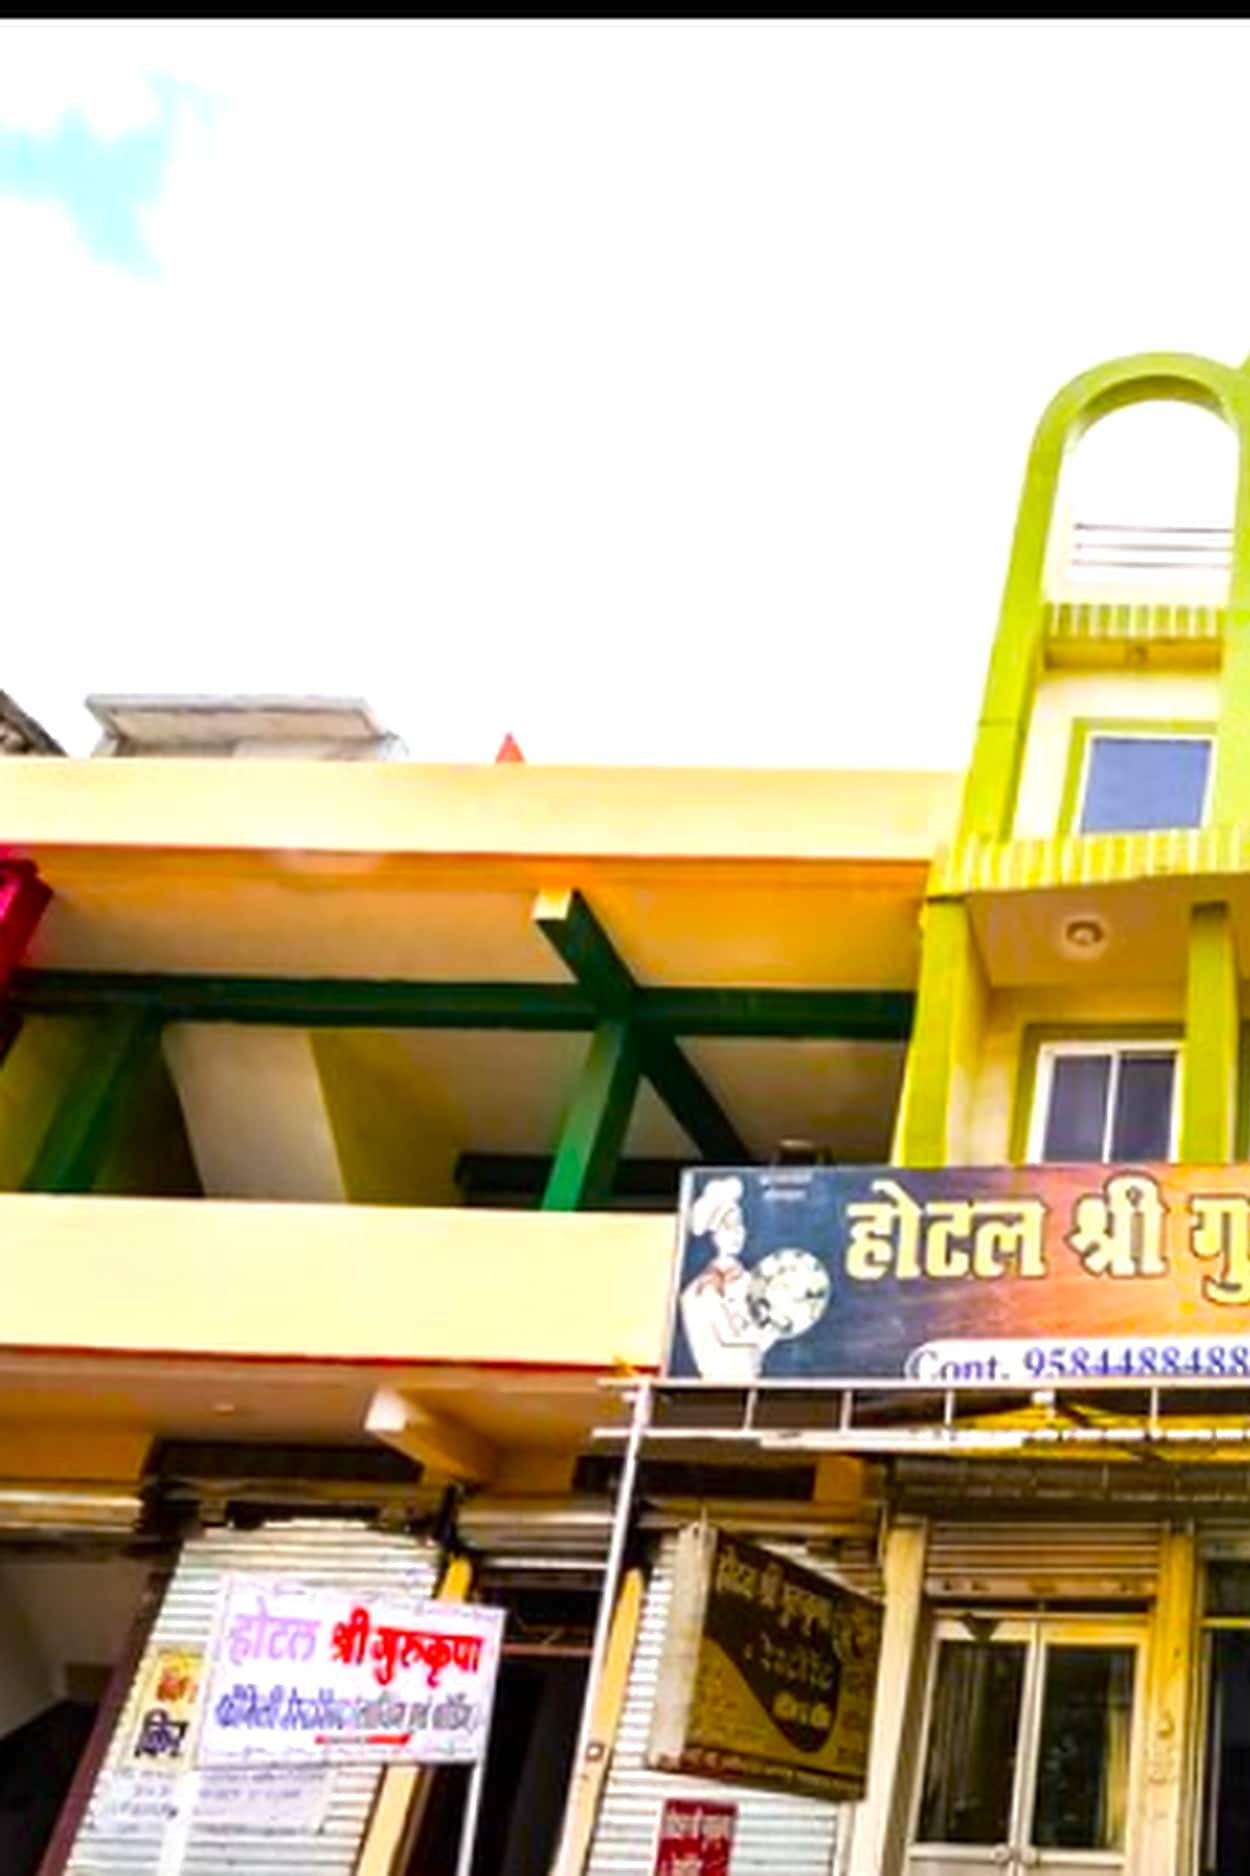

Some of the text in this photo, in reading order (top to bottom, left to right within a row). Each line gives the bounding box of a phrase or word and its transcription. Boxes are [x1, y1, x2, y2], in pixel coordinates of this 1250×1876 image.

[845, 1179, 1047, 1279] होटल
[1065, 1172, 1168, 1278] श्री
[229, 1594, 321, 1666] होटल
[332, 1606, 369, 1666] श्री
